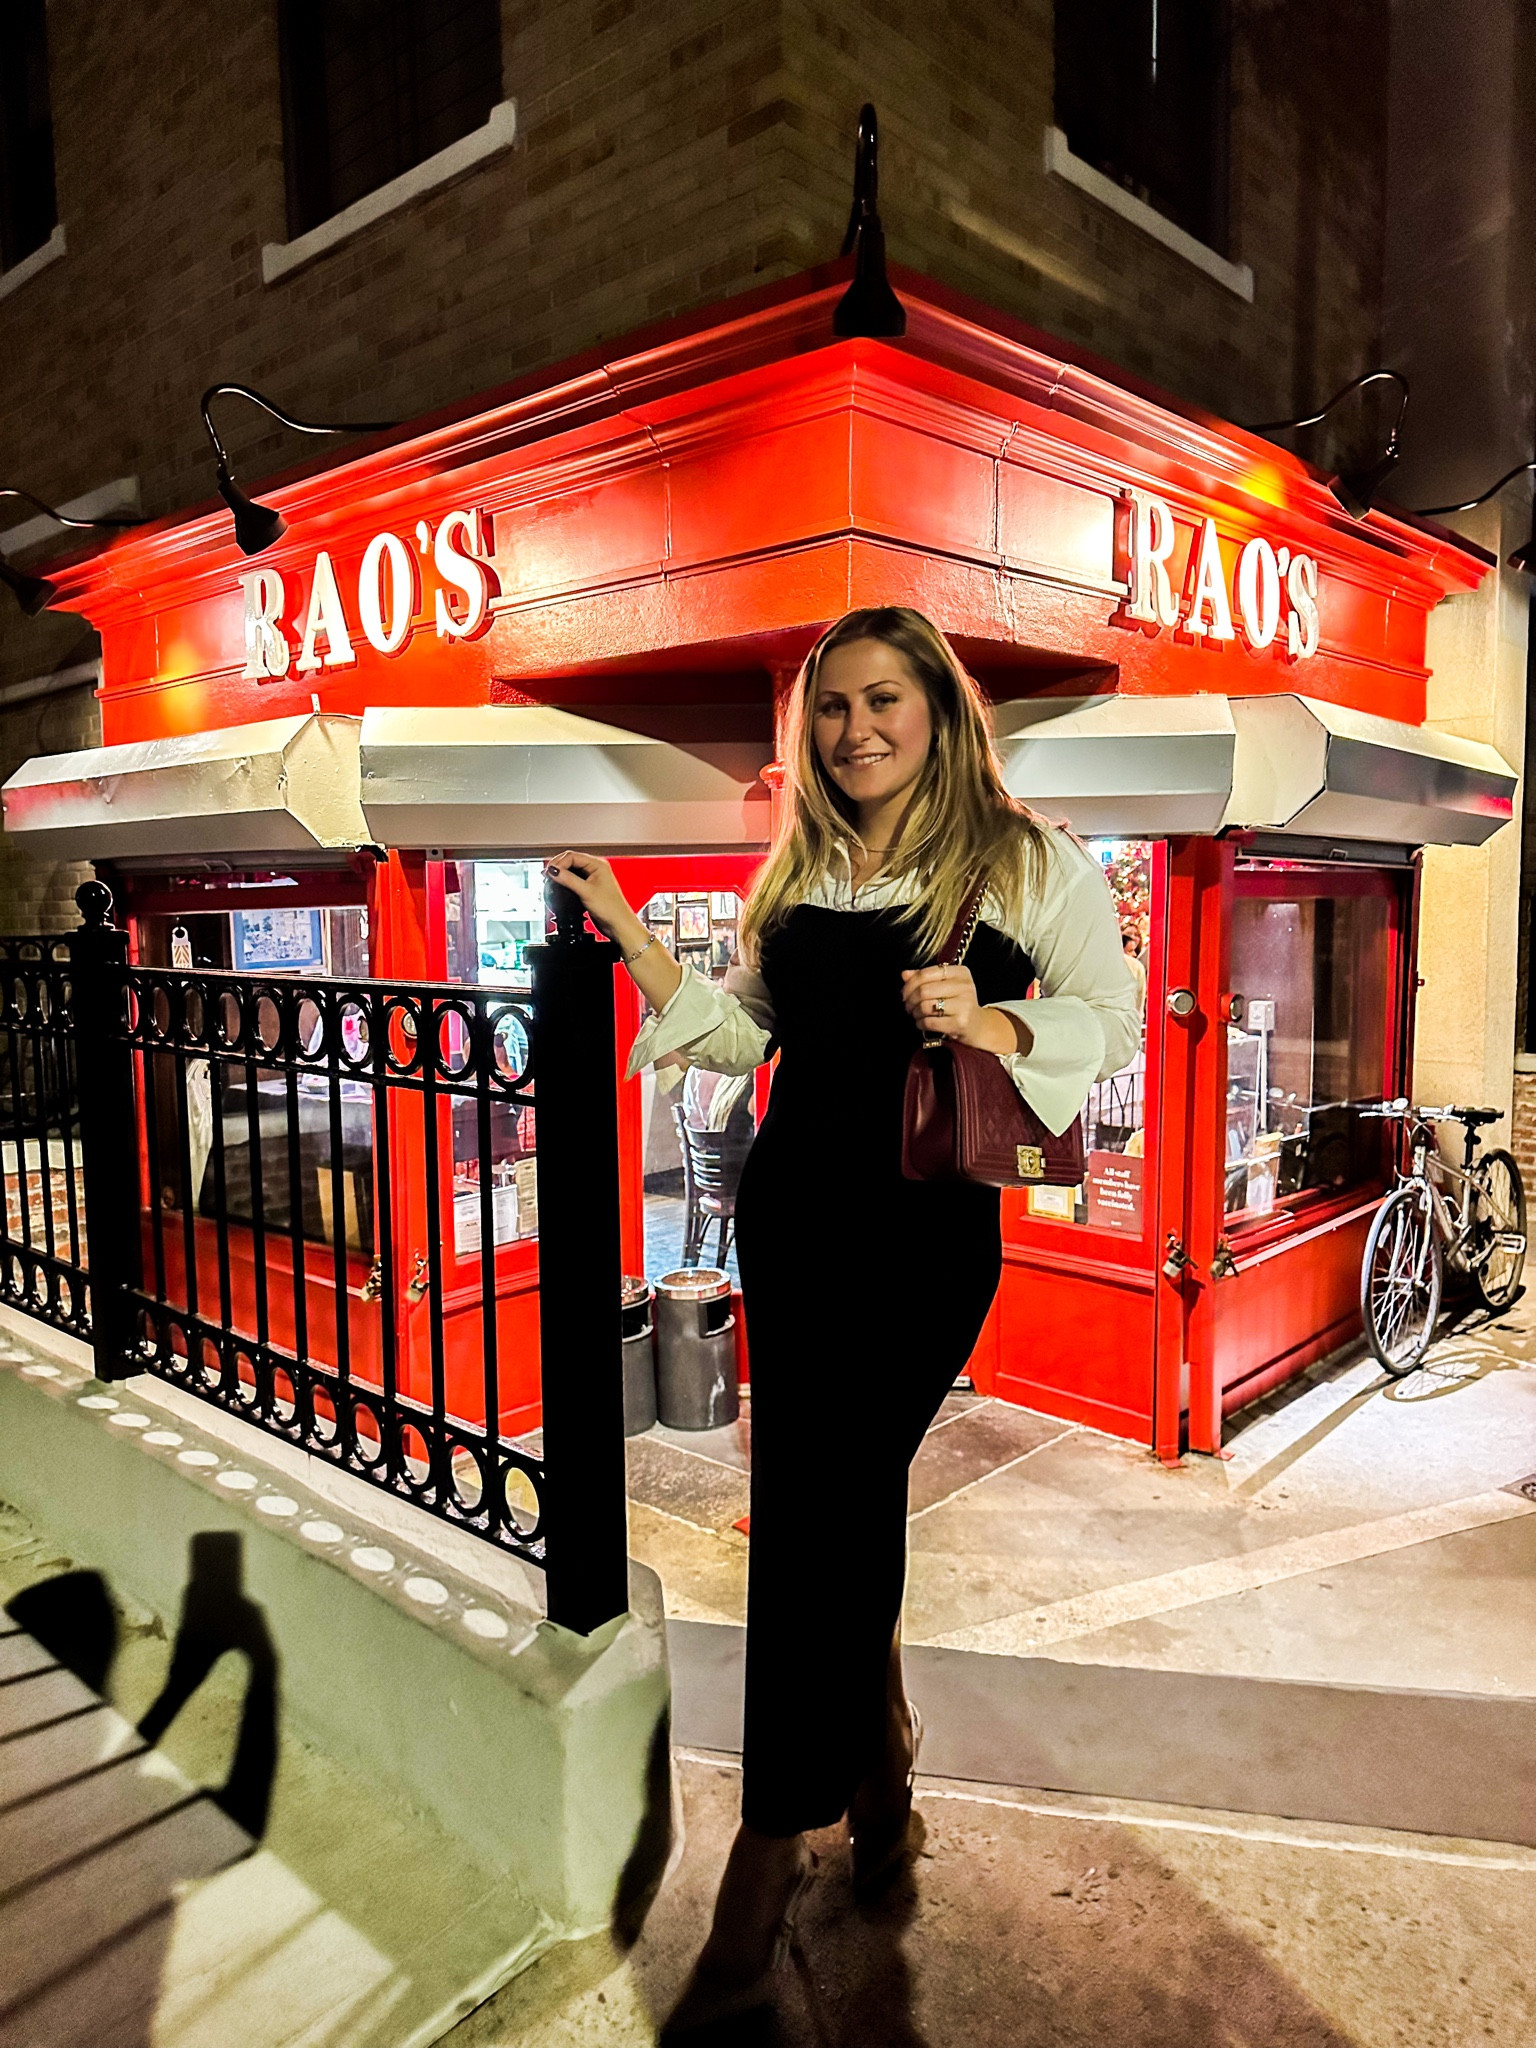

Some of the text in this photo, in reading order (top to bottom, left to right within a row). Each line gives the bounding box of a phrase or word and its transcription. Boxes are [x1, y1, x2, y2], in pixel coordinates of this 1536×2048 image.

[238, 508, 488, 680] RAO'S
[1126, 488, 1320, 660] RAO'S
[1092, 1177, 1124, 1188] members
[1104, 1167, 1115, 1176] All
